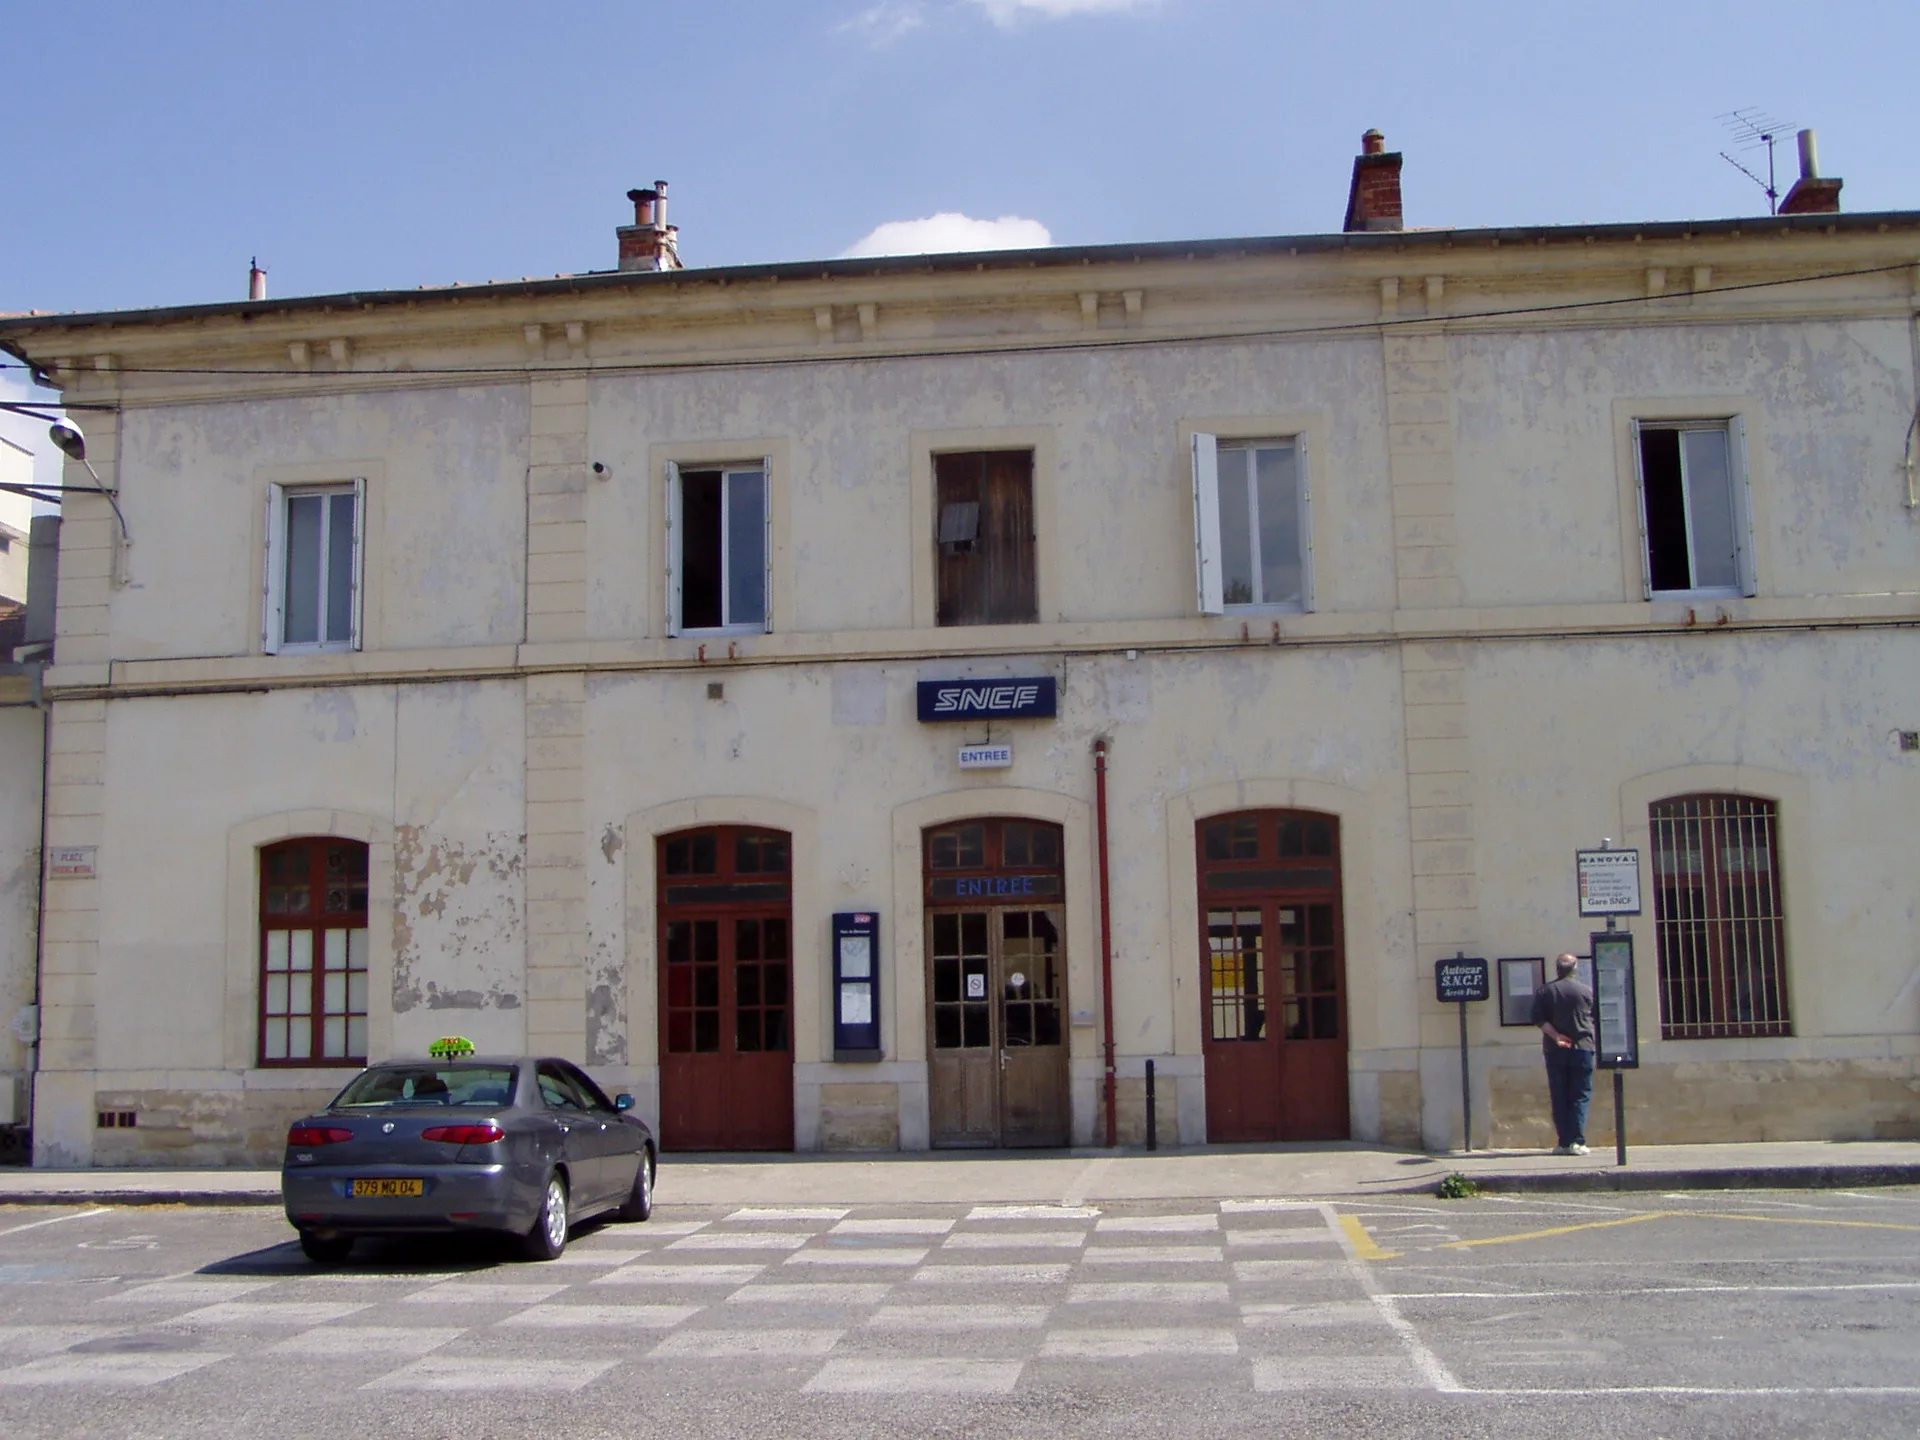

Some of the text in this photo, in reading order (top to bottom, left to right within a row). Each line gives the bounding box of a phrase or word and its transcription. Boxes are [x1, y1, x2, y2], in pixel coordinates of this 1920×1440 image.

[934, 685, 1039, 711] SNCF
[961, 750, 1008, 762] ENTREE
[60, 853, 83, 862] PLACE
[956, 877, 1033, 896] ENTREE
[1588, 897, 1633, 906] Gare SNCF
[1441, 964, 1482, 976] Autocar
[1441, 975, 1483, 987] S.N.C.F.
[443, 1037, 461, 1046] TAXI
[356, 1180, 415, 1194] 379 MQ 04
